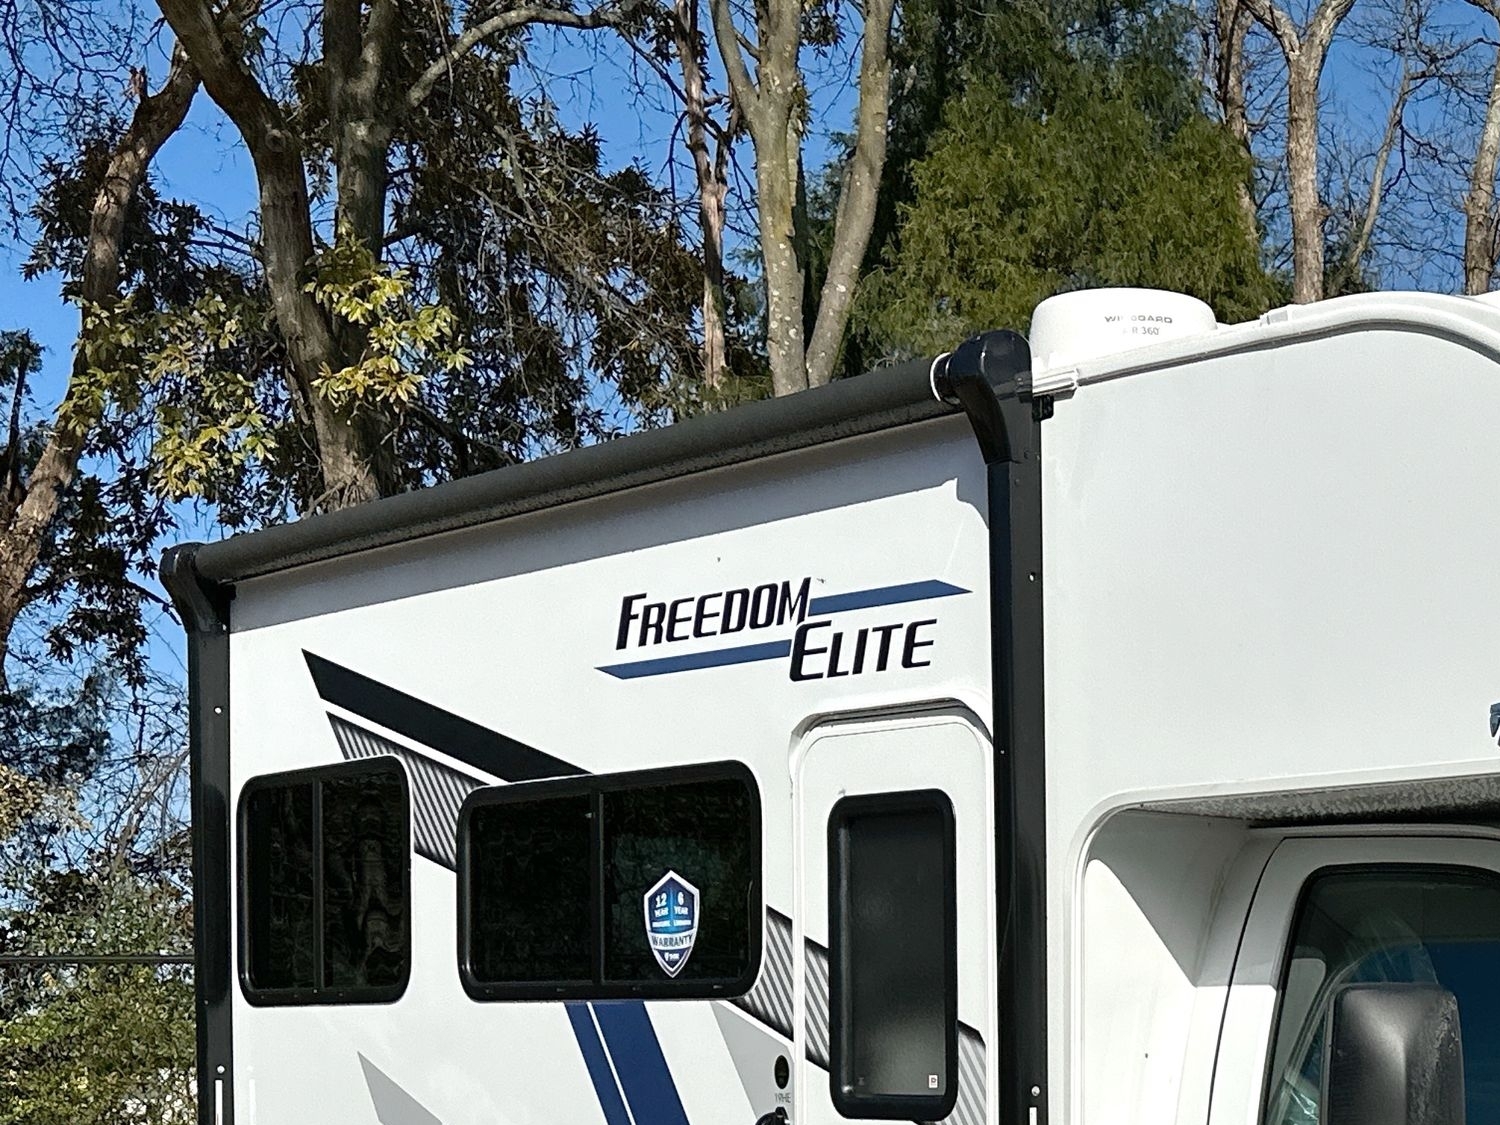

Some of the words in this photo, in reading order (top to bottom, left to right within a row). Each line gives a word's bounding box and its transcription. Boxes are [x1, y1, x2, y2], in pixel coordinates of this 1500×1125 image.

[615, 576, 812, 651] FREEDOM
[789, 618, 938, 683] ELITE
[655, 892, 668, 909] 12
[651, 933, 693, 947] WARRANTY
